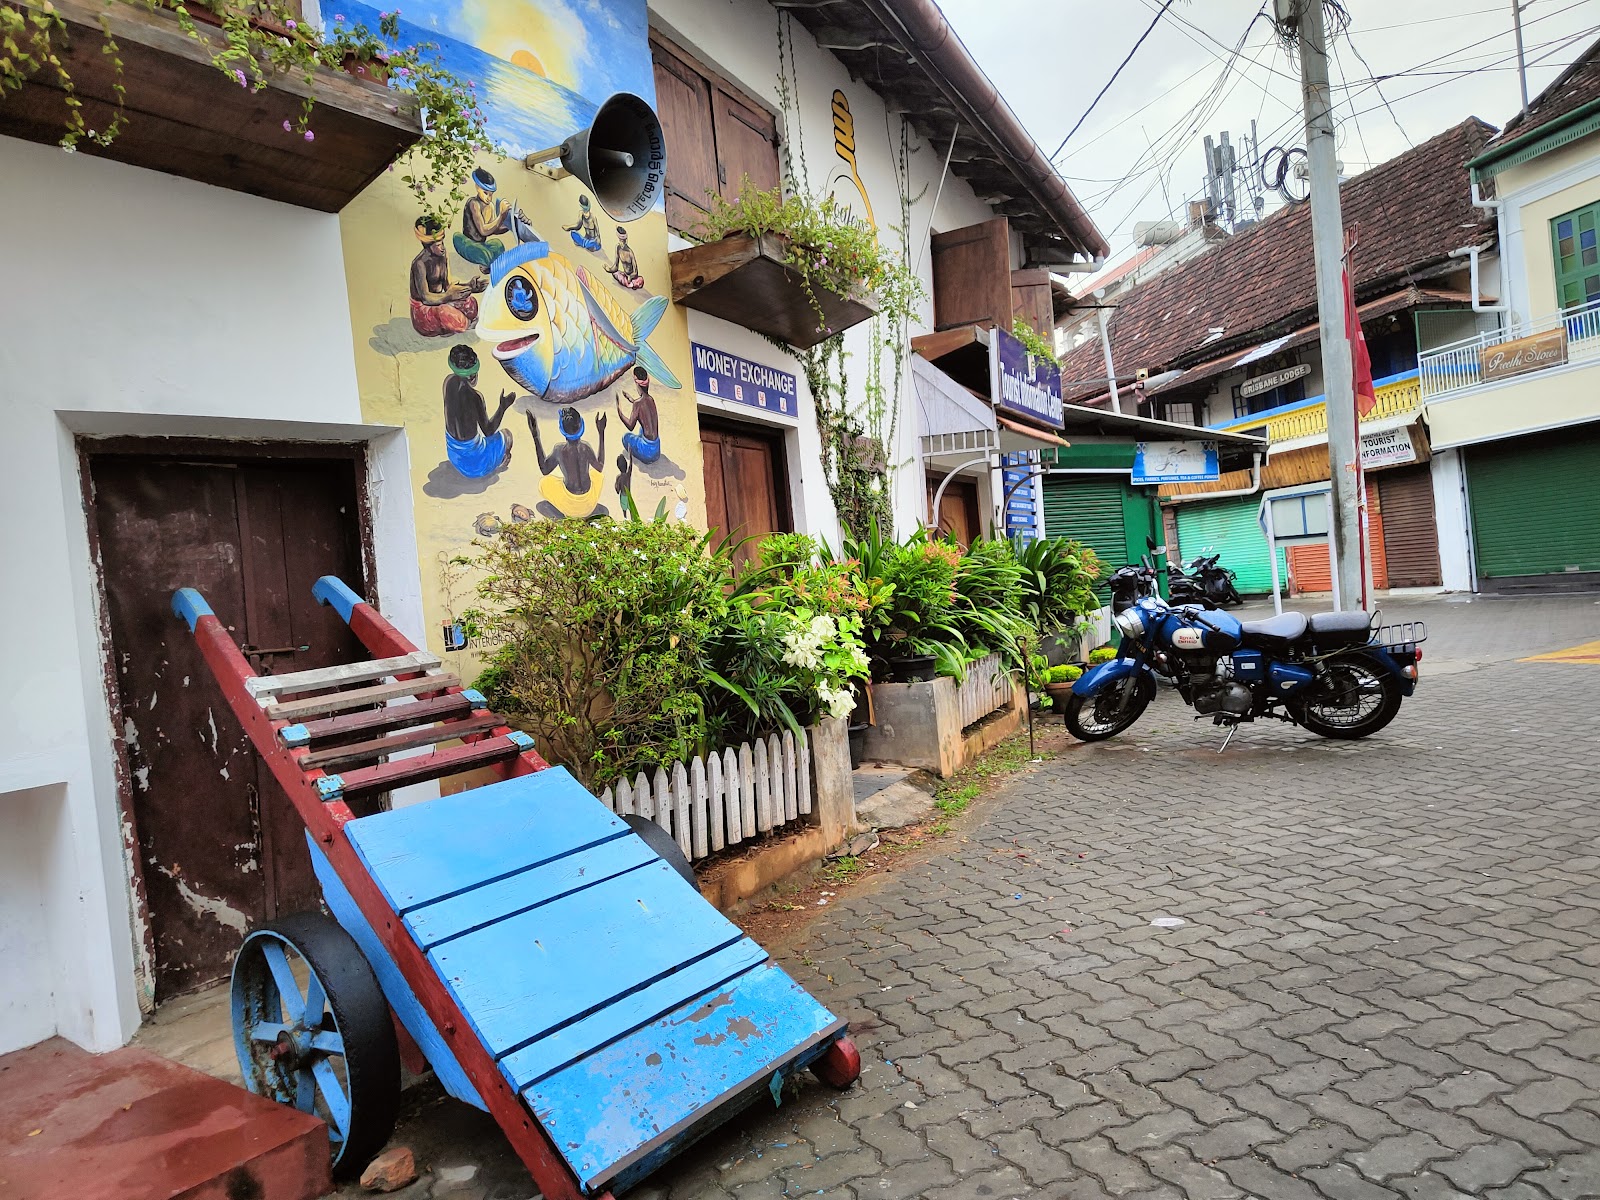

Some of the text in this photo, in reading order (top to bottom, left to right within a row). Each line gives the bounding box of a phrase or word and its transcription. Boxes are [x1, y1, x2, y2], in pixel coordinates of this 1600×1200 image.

[696, 346, 795, 396] MONEY EXCHANGE
[1488, 343, 1558, 373] Preethi Stores
[1000, 361, 1020, 405] Tourist
[1243, 376, 1279, 396] BRISBANE
[1280, 366, 1306, 383] LODGE
[1361, 442, 1411, 459] NFORMATION
[1363, 435, 1396, 449] TOURIST
